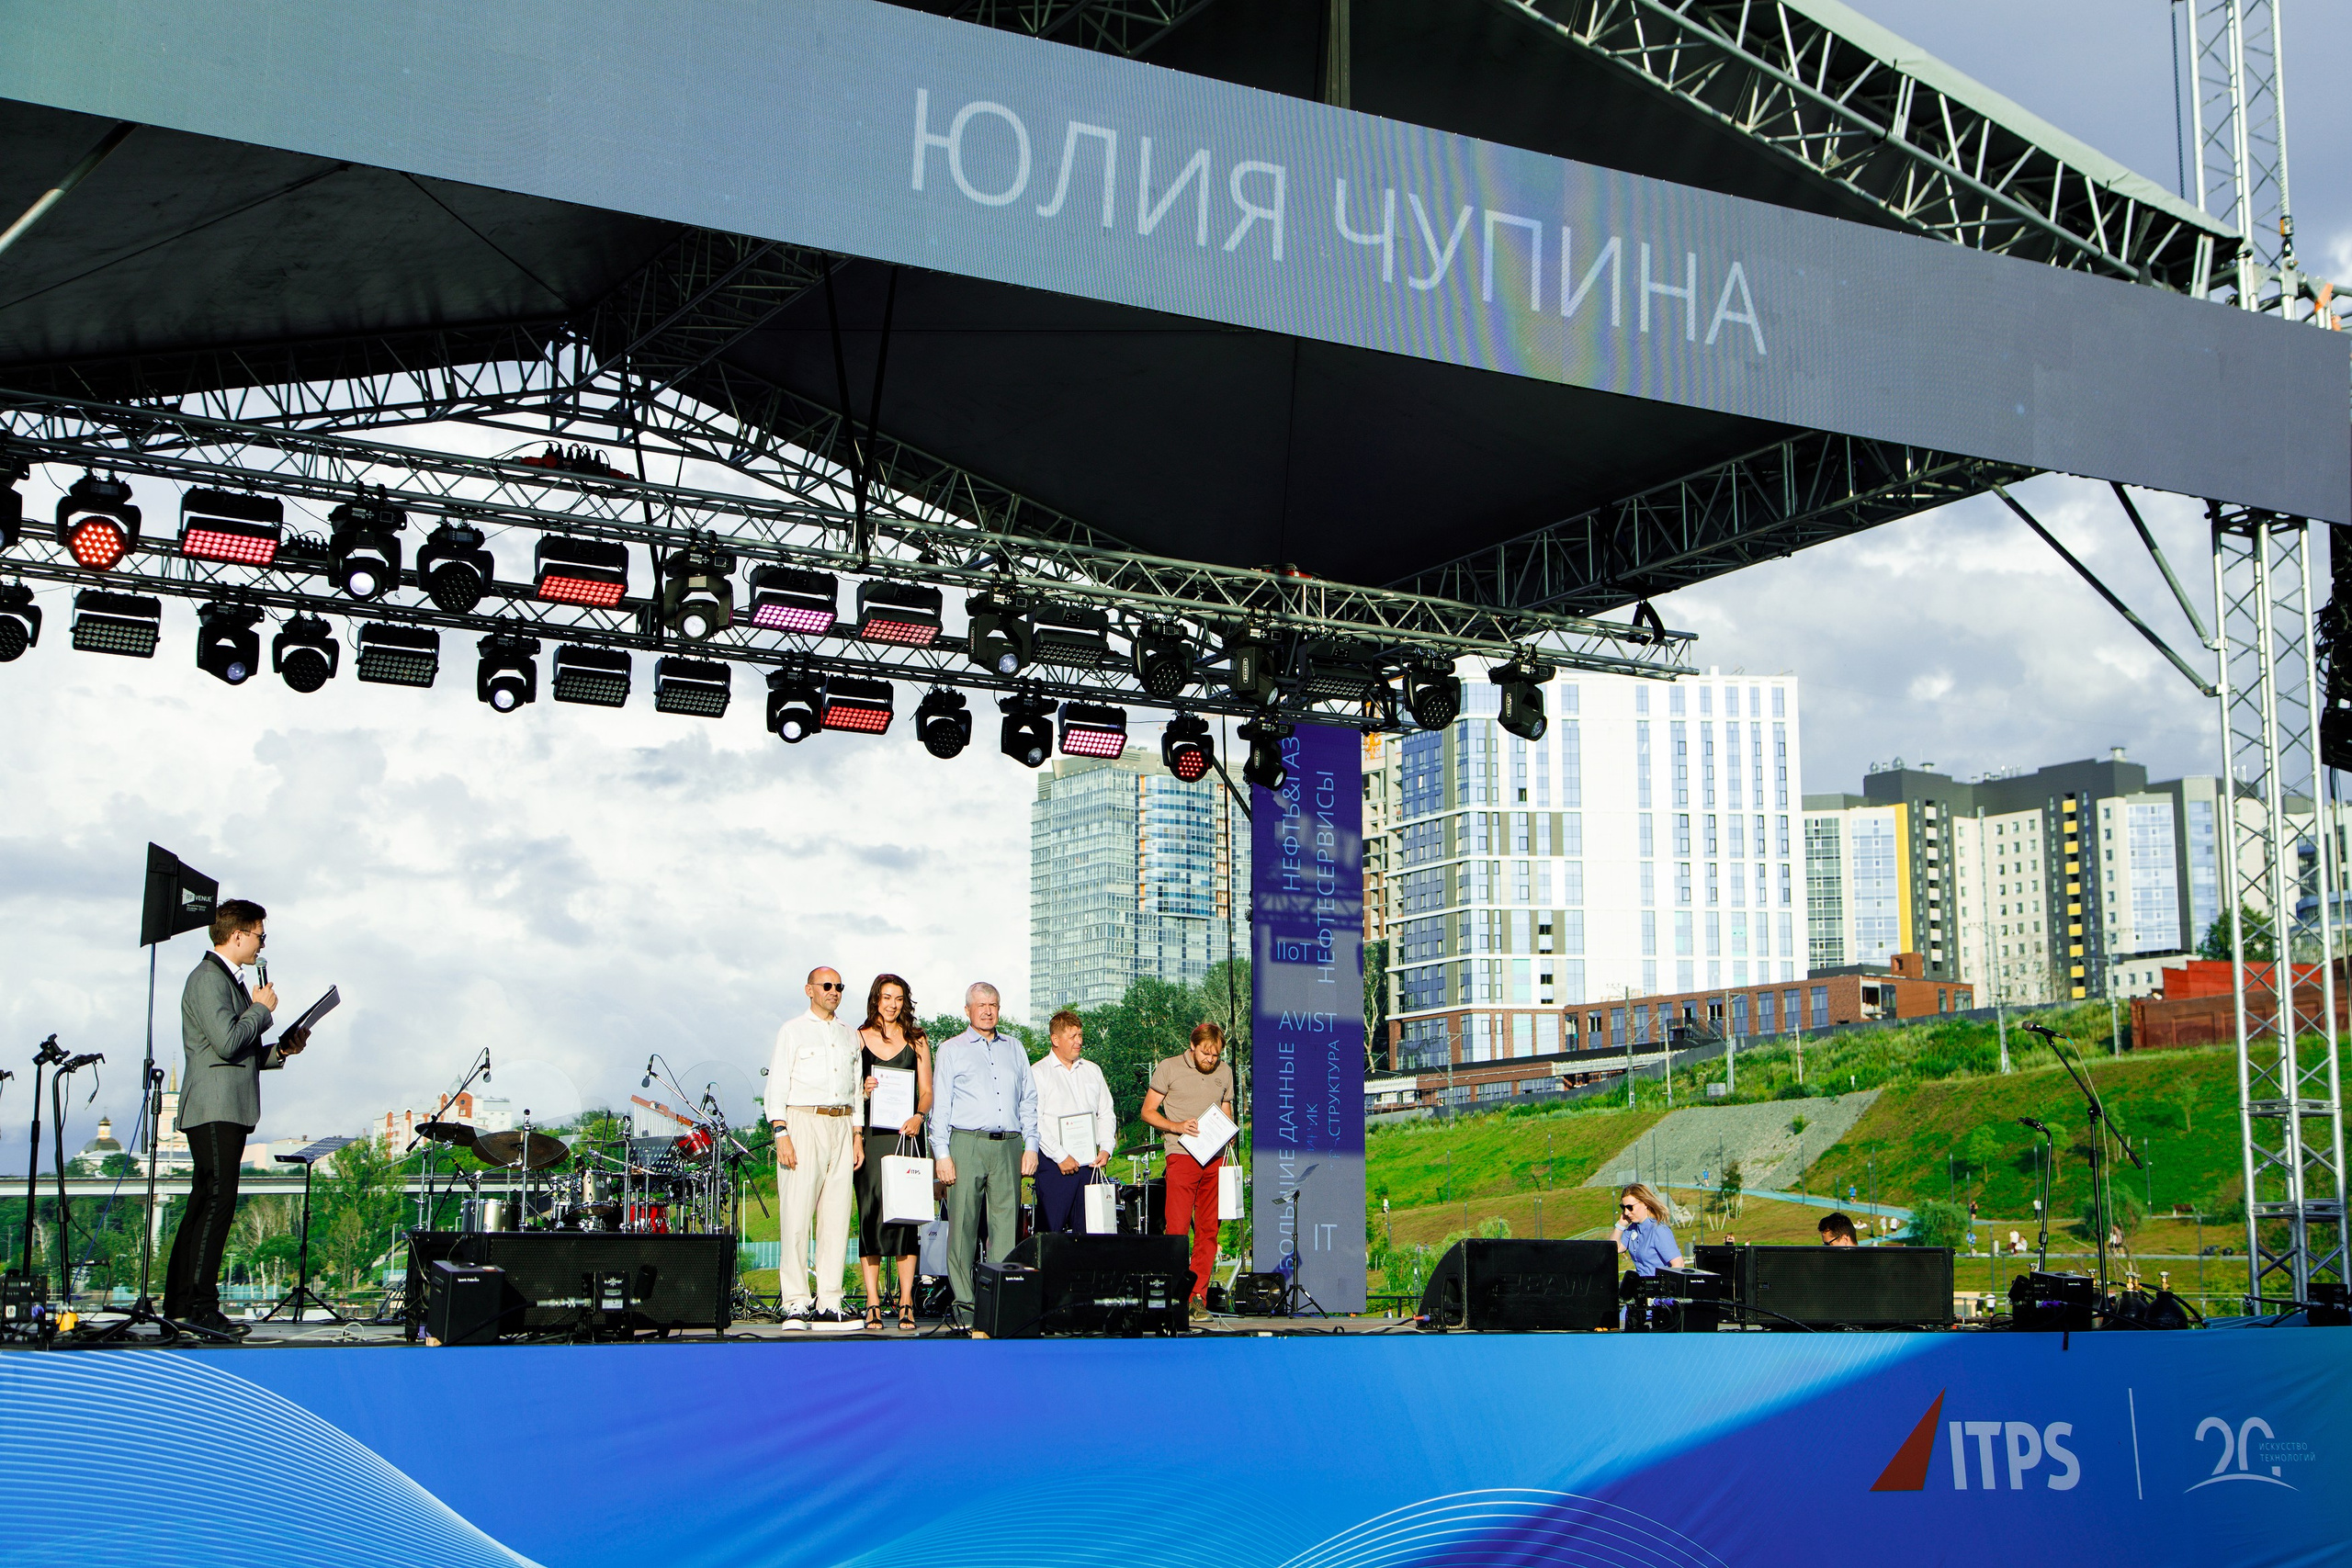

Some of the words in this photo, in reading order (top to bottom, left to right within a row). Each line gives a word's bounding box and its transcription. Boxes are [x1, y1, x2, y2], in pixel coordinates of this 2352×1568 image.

[911, 87, 1287, 263] ЮЛИЯ
[1335, 177, 1768, 356] ЧУПИНА
[1317, 771, 1336, 984] НЕФТЕСЕРВИСЫ
[1278, 1010, 1338, 1033] AVIST
[1279, 1042, 1298, 1143] ДАННЫЕ
[1314, 1223, 1338, 1251] IT
[1948, 1421, 2081, 1491] ITPS
[2258, 1442, 2308, 1451] ИСКУССТВО
[2259, 1451, 2316, 1462] ТЕХНОЛОГИЙ
